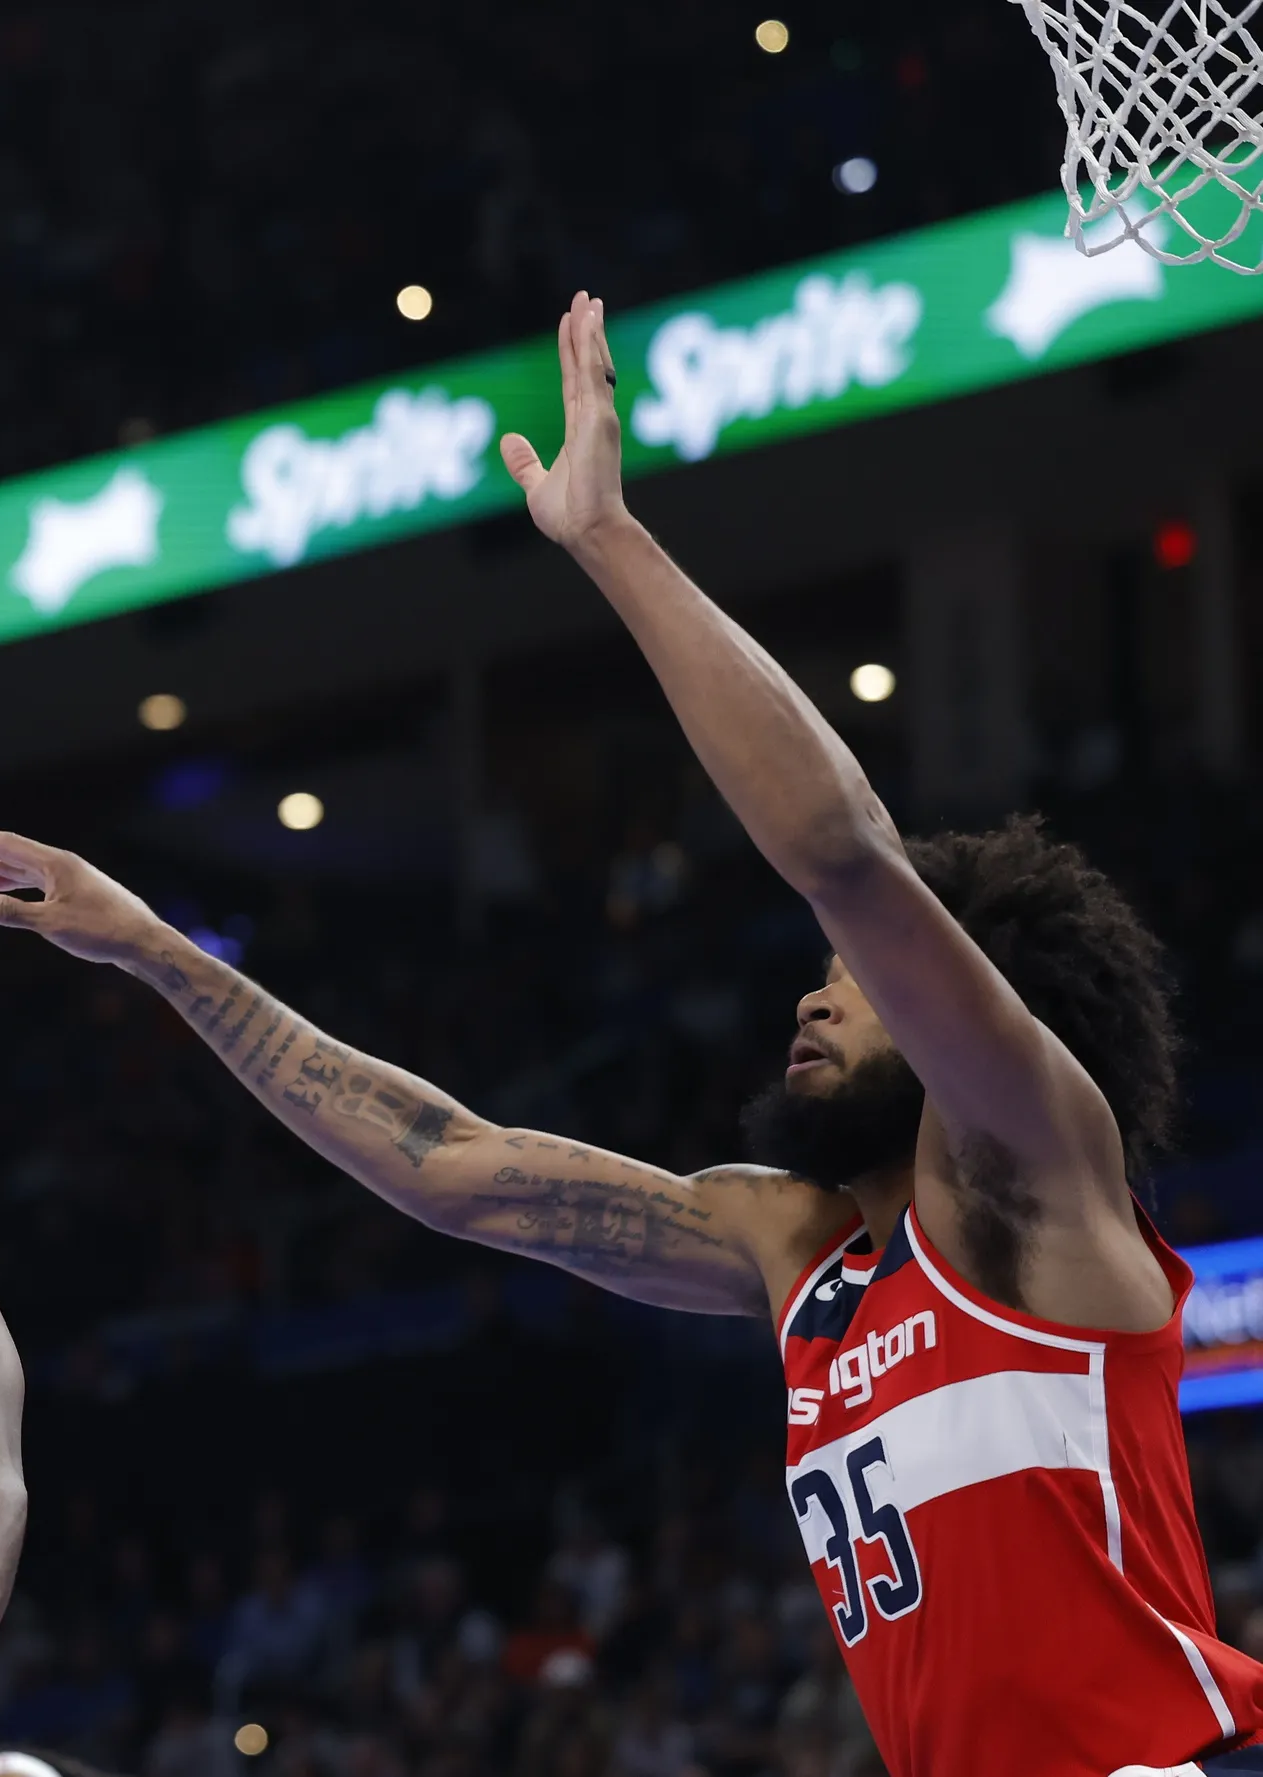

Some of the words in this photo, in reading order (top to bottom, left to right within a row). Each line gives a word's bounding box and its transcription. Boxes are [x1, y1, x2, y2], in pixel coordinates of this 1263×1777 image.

[631, 272, 923, 459] Sprite
[227, 387, 494, 564] Sprite
[787, 1431, 923, 1648] 35
